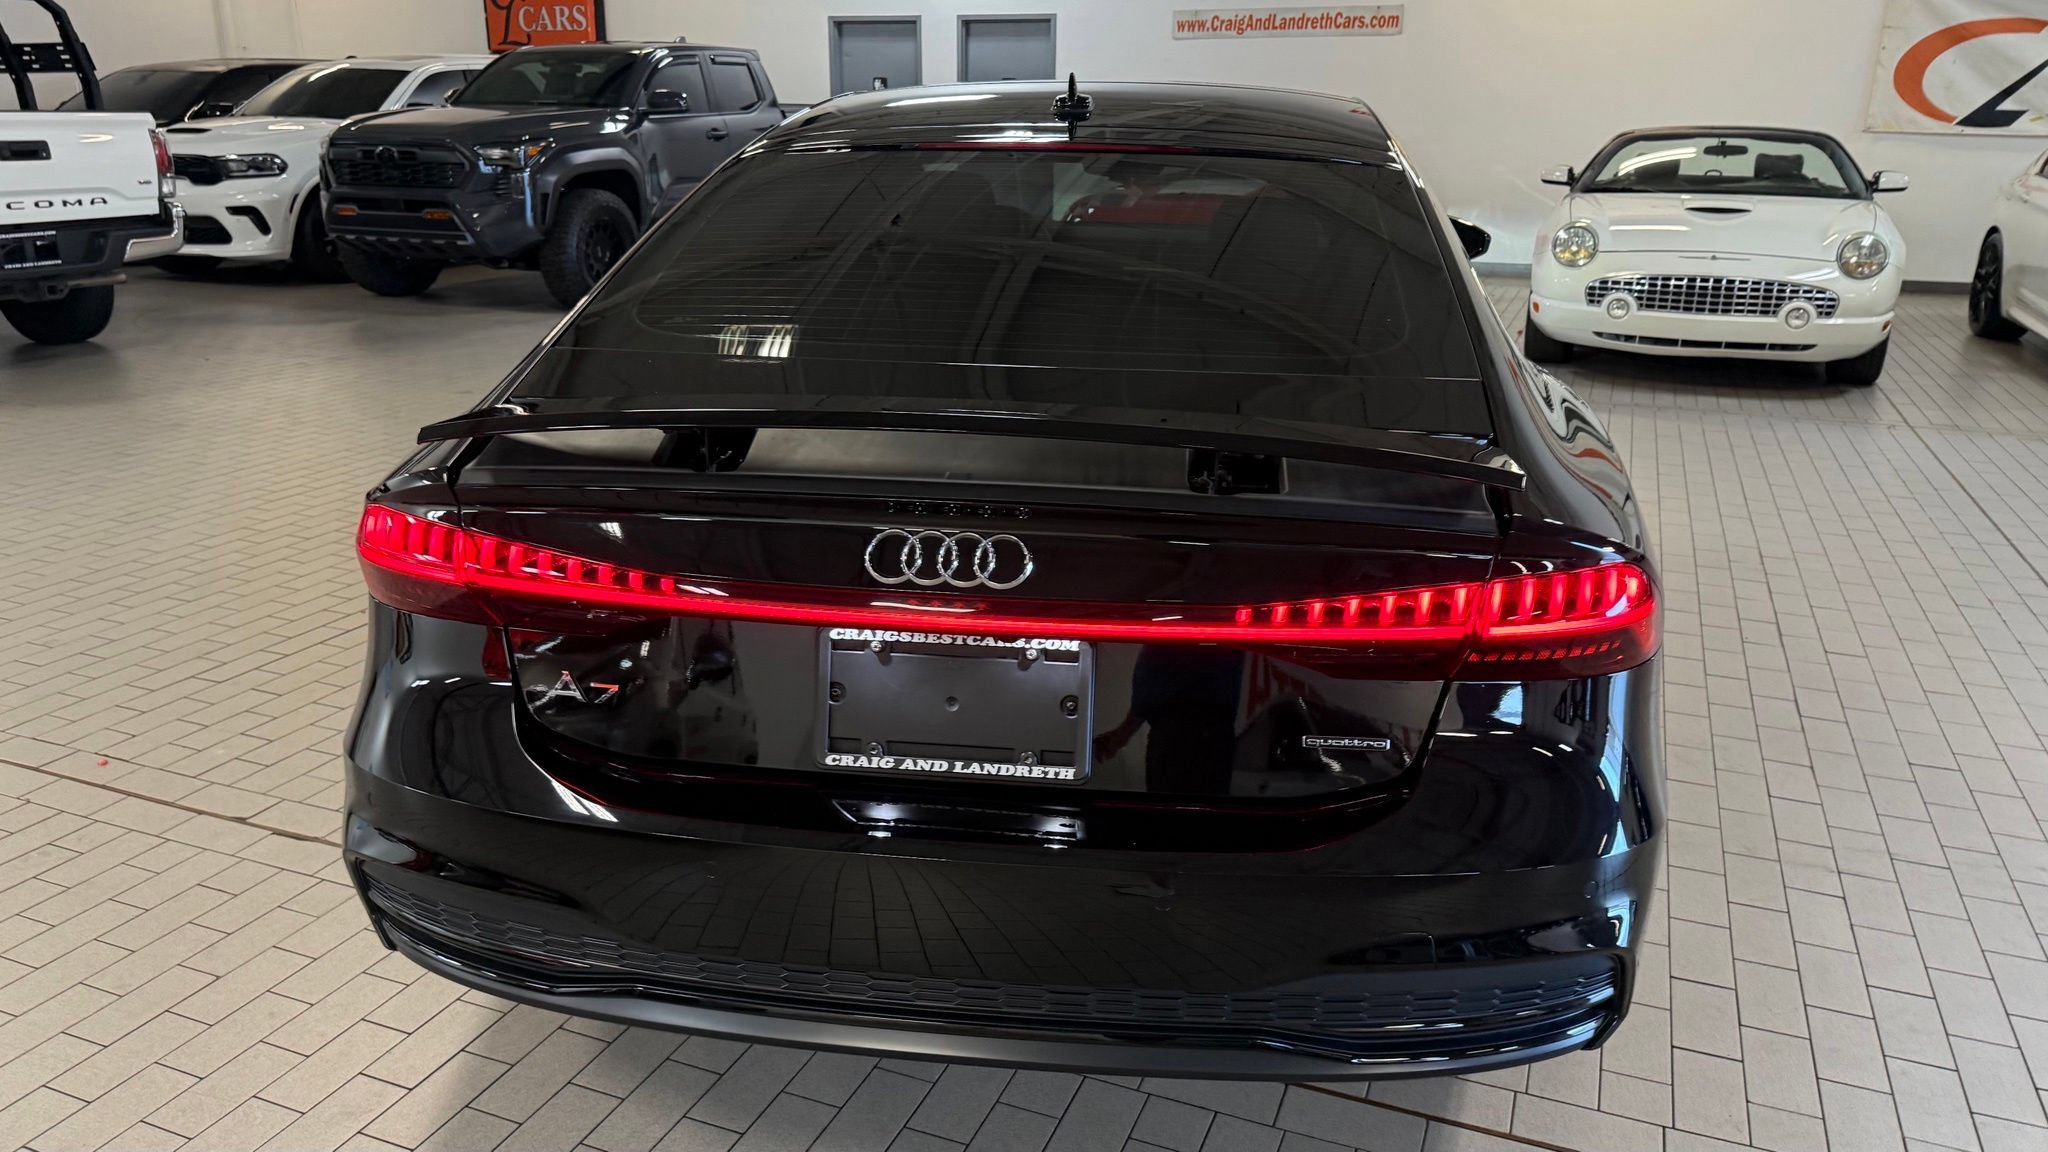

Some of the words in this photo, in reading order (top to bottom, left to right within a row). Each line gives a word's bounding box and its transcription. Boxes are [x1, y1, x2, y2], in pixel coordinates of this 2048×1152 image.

[518, 5, 588, 32] CARS
[1175, 12, 1400, 35] www.CraigAndLandrethCars.com
[540, 670, 620, 703] A7
[1306, 738, 1387, 749] quattro
[825, 754, 896, 769] CRAIG
[898, 758, 949, 772] AND
[952, 761, 1076, 780] LANDRETH
